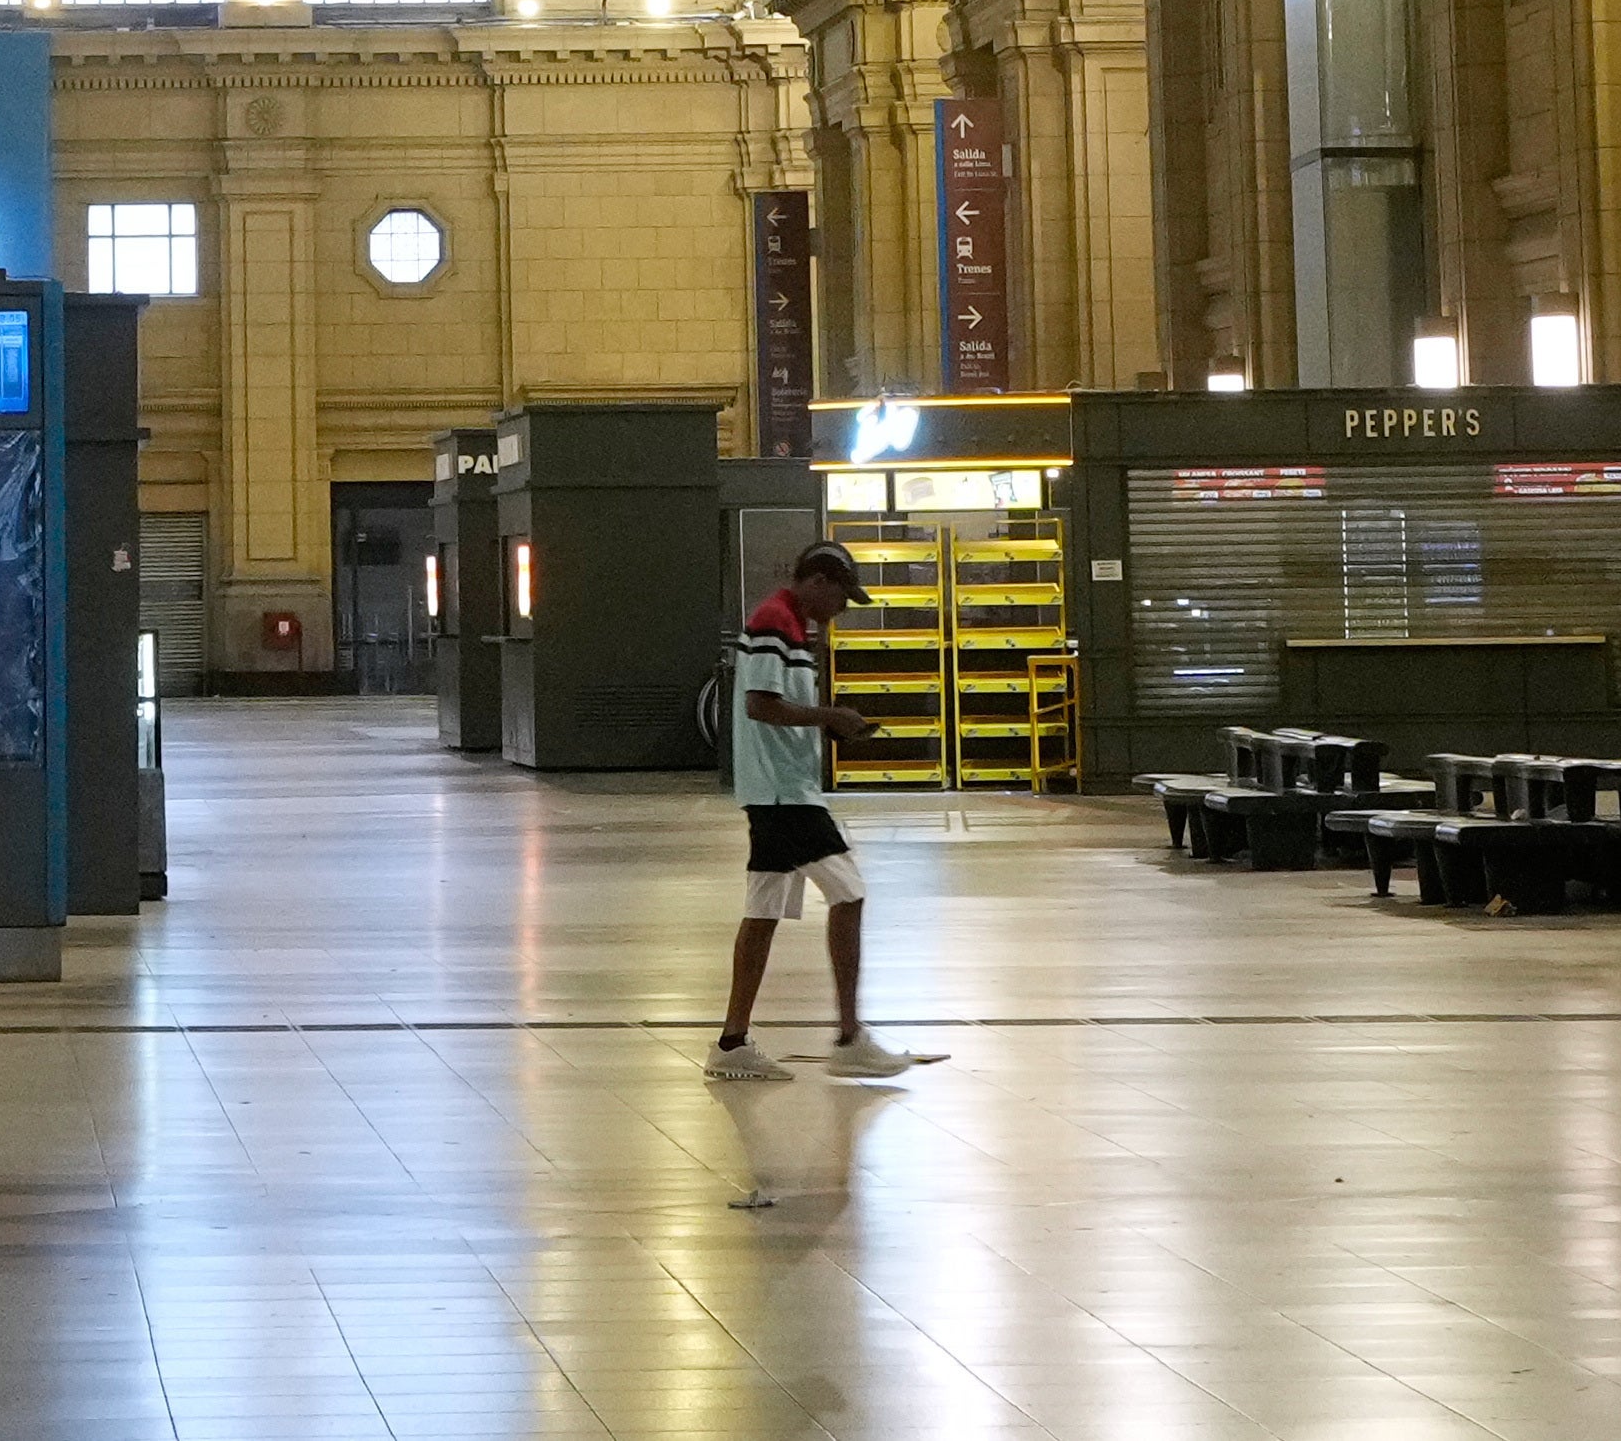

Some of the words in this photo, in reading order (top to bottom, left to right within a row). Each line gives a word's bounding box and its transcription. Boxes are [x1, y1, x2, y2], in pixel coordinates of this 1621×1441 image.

[953, 149, 986, 160] Salida
[956, 263, 993, 275] Trenes
[959, 341, 992, 353] Salida
[1345, 408, 1482, 438] PEPPER'S
